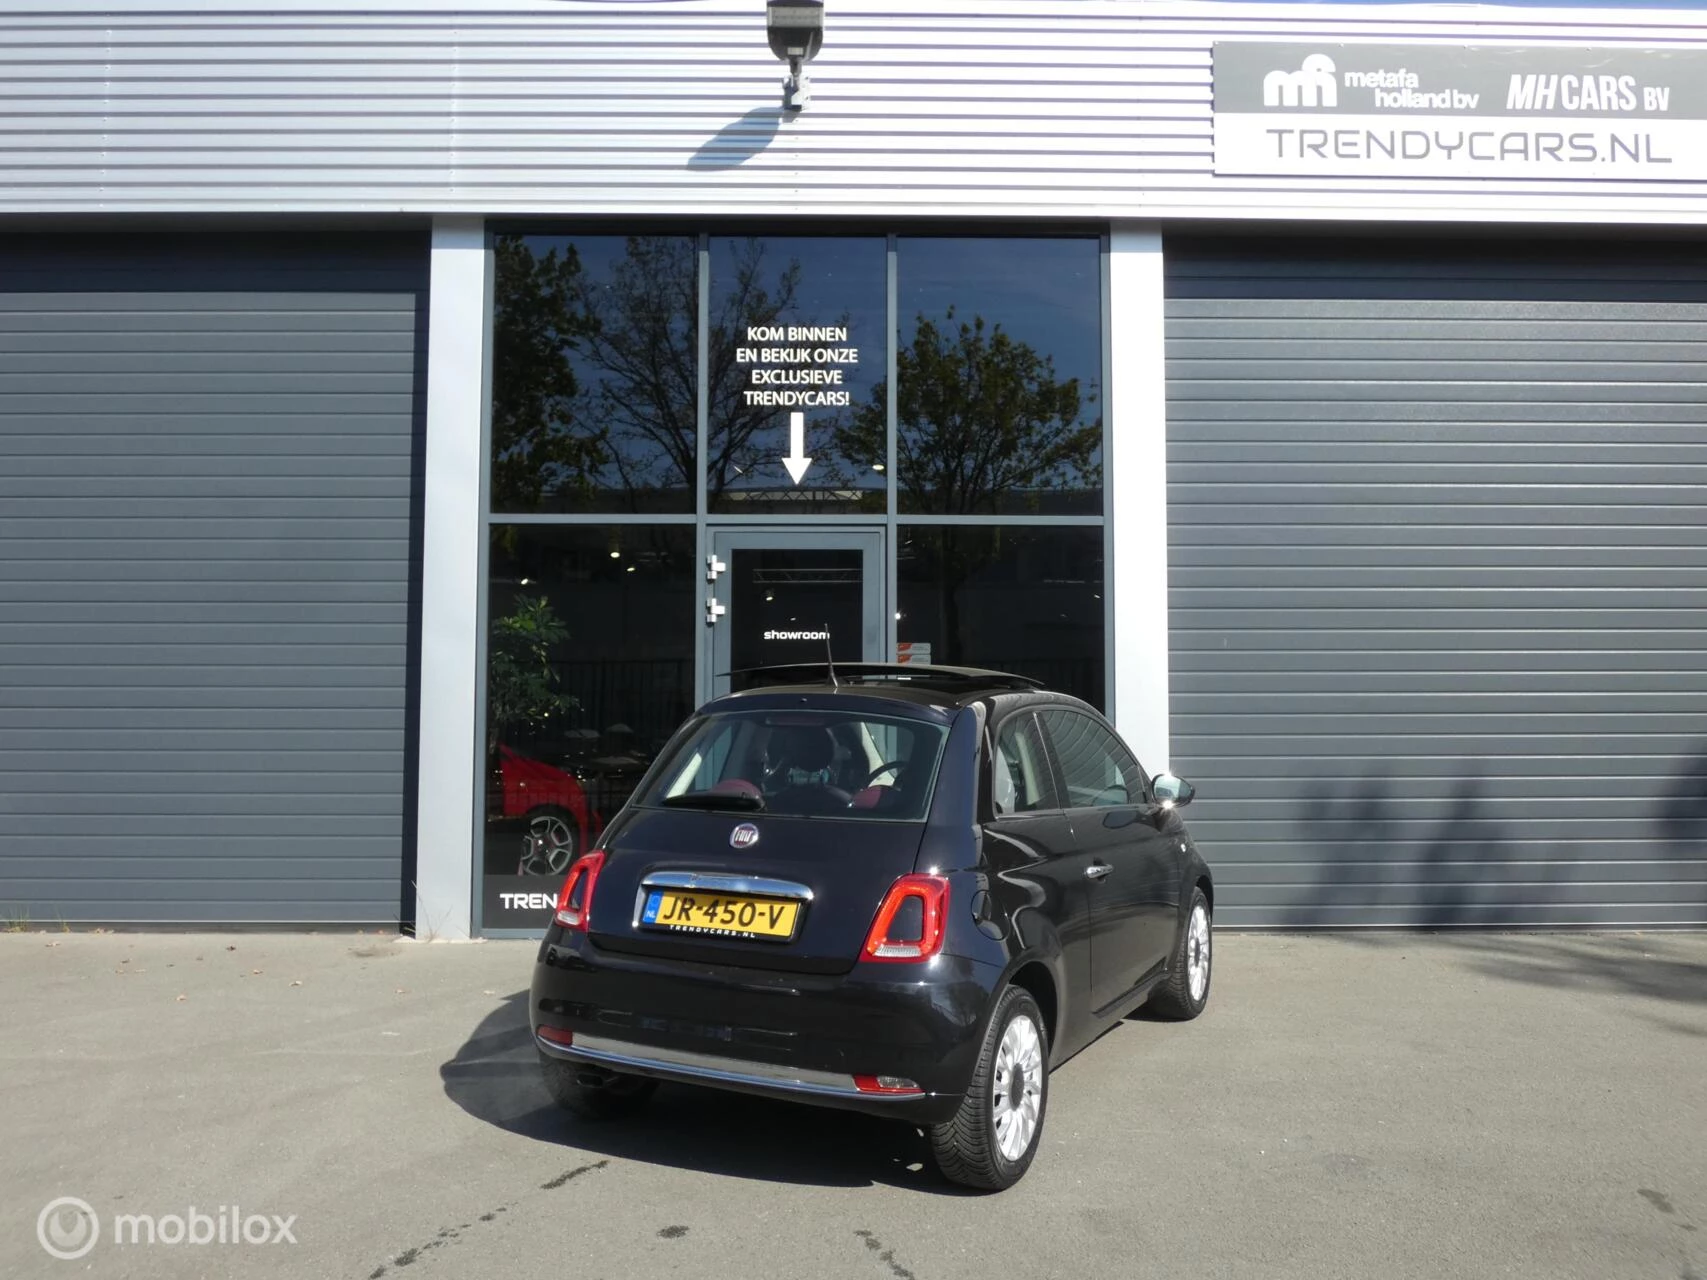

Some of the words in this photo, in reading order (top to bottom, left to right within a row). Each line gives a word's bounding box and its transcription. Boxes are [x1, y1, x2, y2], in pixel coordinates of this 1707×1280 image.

[1344, 68, 1419, 88] metafa
[1643, 87, 1670, 111] BV
[1266, 129, 1672, 163] TRENDYCARS.NL
[747, 327, 784, 341] KOM
[788, 327, 846, 341] BINNEN
[736, 348, 757, 363] EN
[761, 348, 811, 363] BEKIJK
[814, 348, 858, 363] ONZE
[751, 370, 842, 384] EXCLUSIEVE
[744, 391, 849, 405] TRENDYCARS!
[763, 630, 830, 640] showroom
[663, 896, 785, 930] JR-450-V
[669, 924, 756, 939] TRENDYCARS.NL
